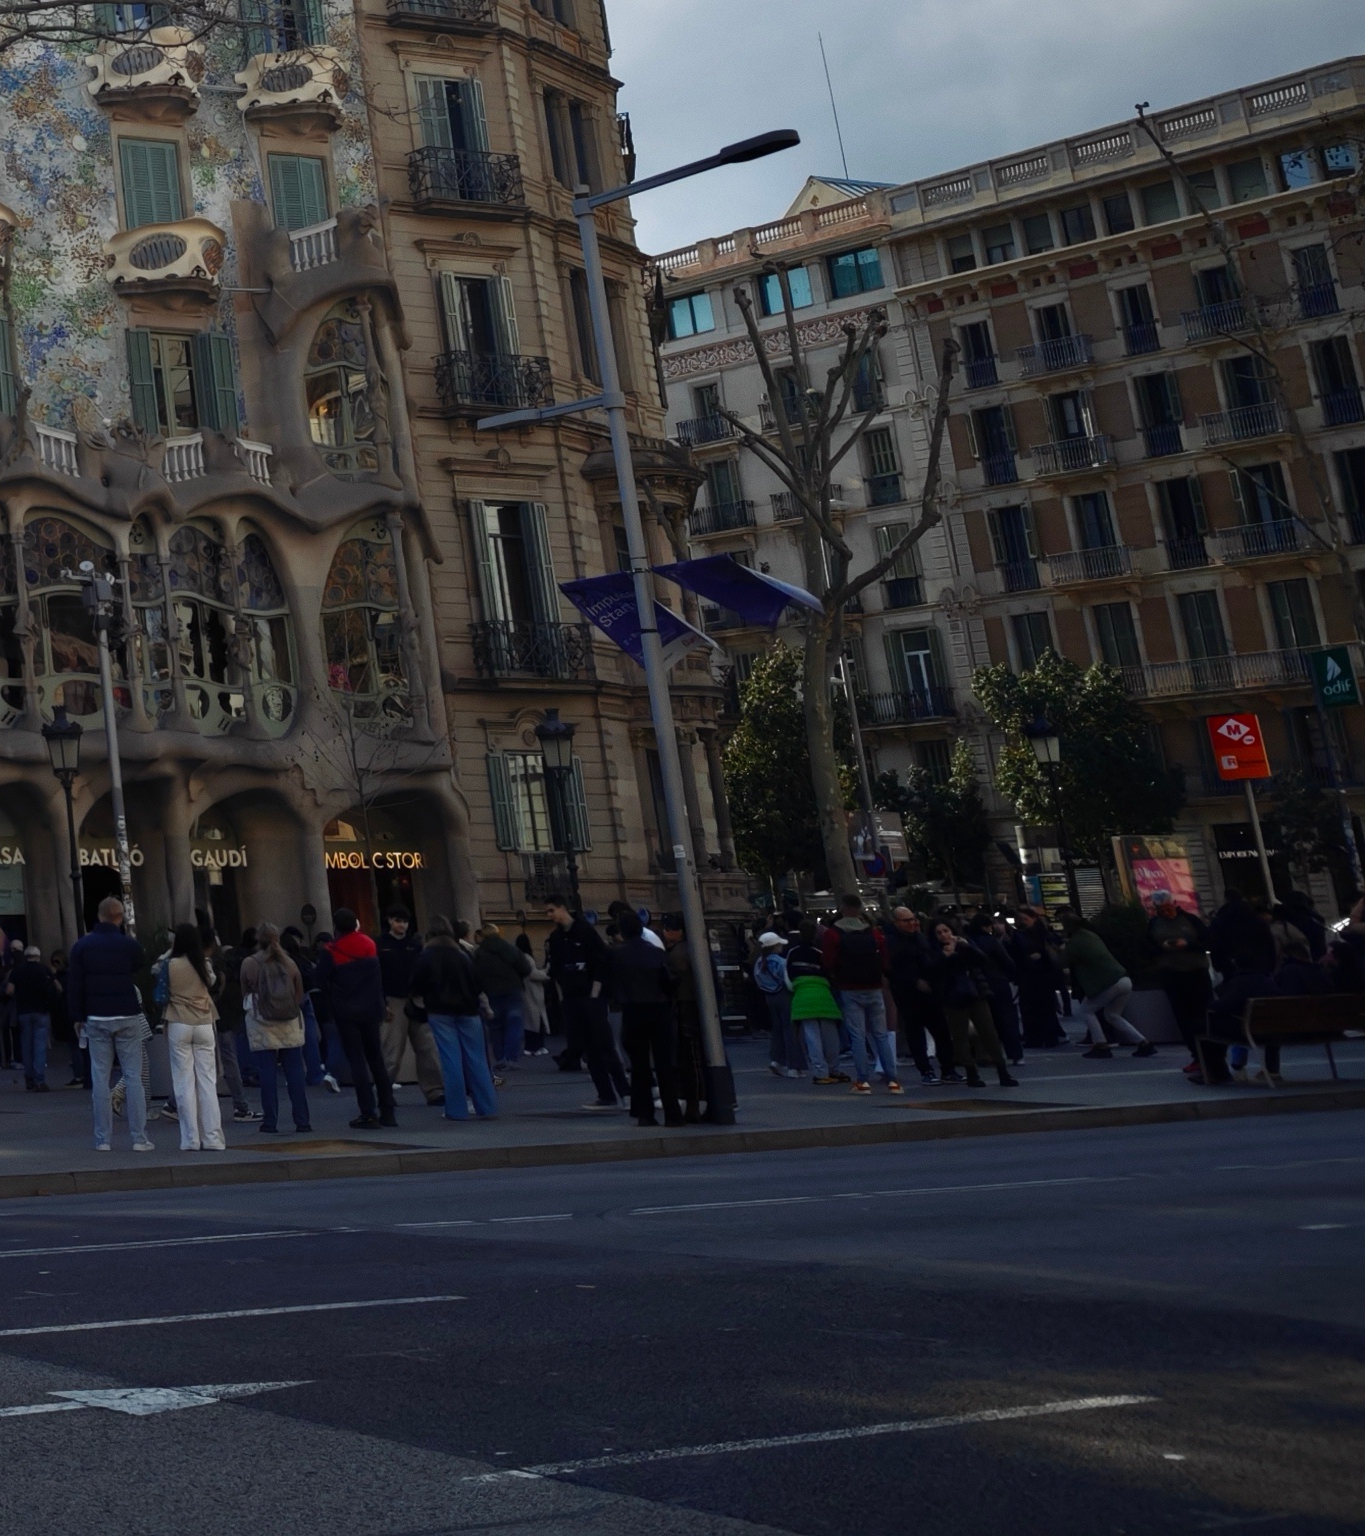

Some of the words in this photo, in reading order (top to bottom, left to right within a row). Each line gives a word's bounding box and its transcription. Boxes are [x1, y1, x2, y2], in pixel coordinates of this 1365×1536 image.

[1226, 724, 1242, 735] M
[80, 843, 145, 867] BATLÓ
[190, 845, 248, 868] GAUDÍ
[324, 851, 370, 870] MBOL
[372, 851, 385, 870] C
[385, 851, 427, 870] STOR
